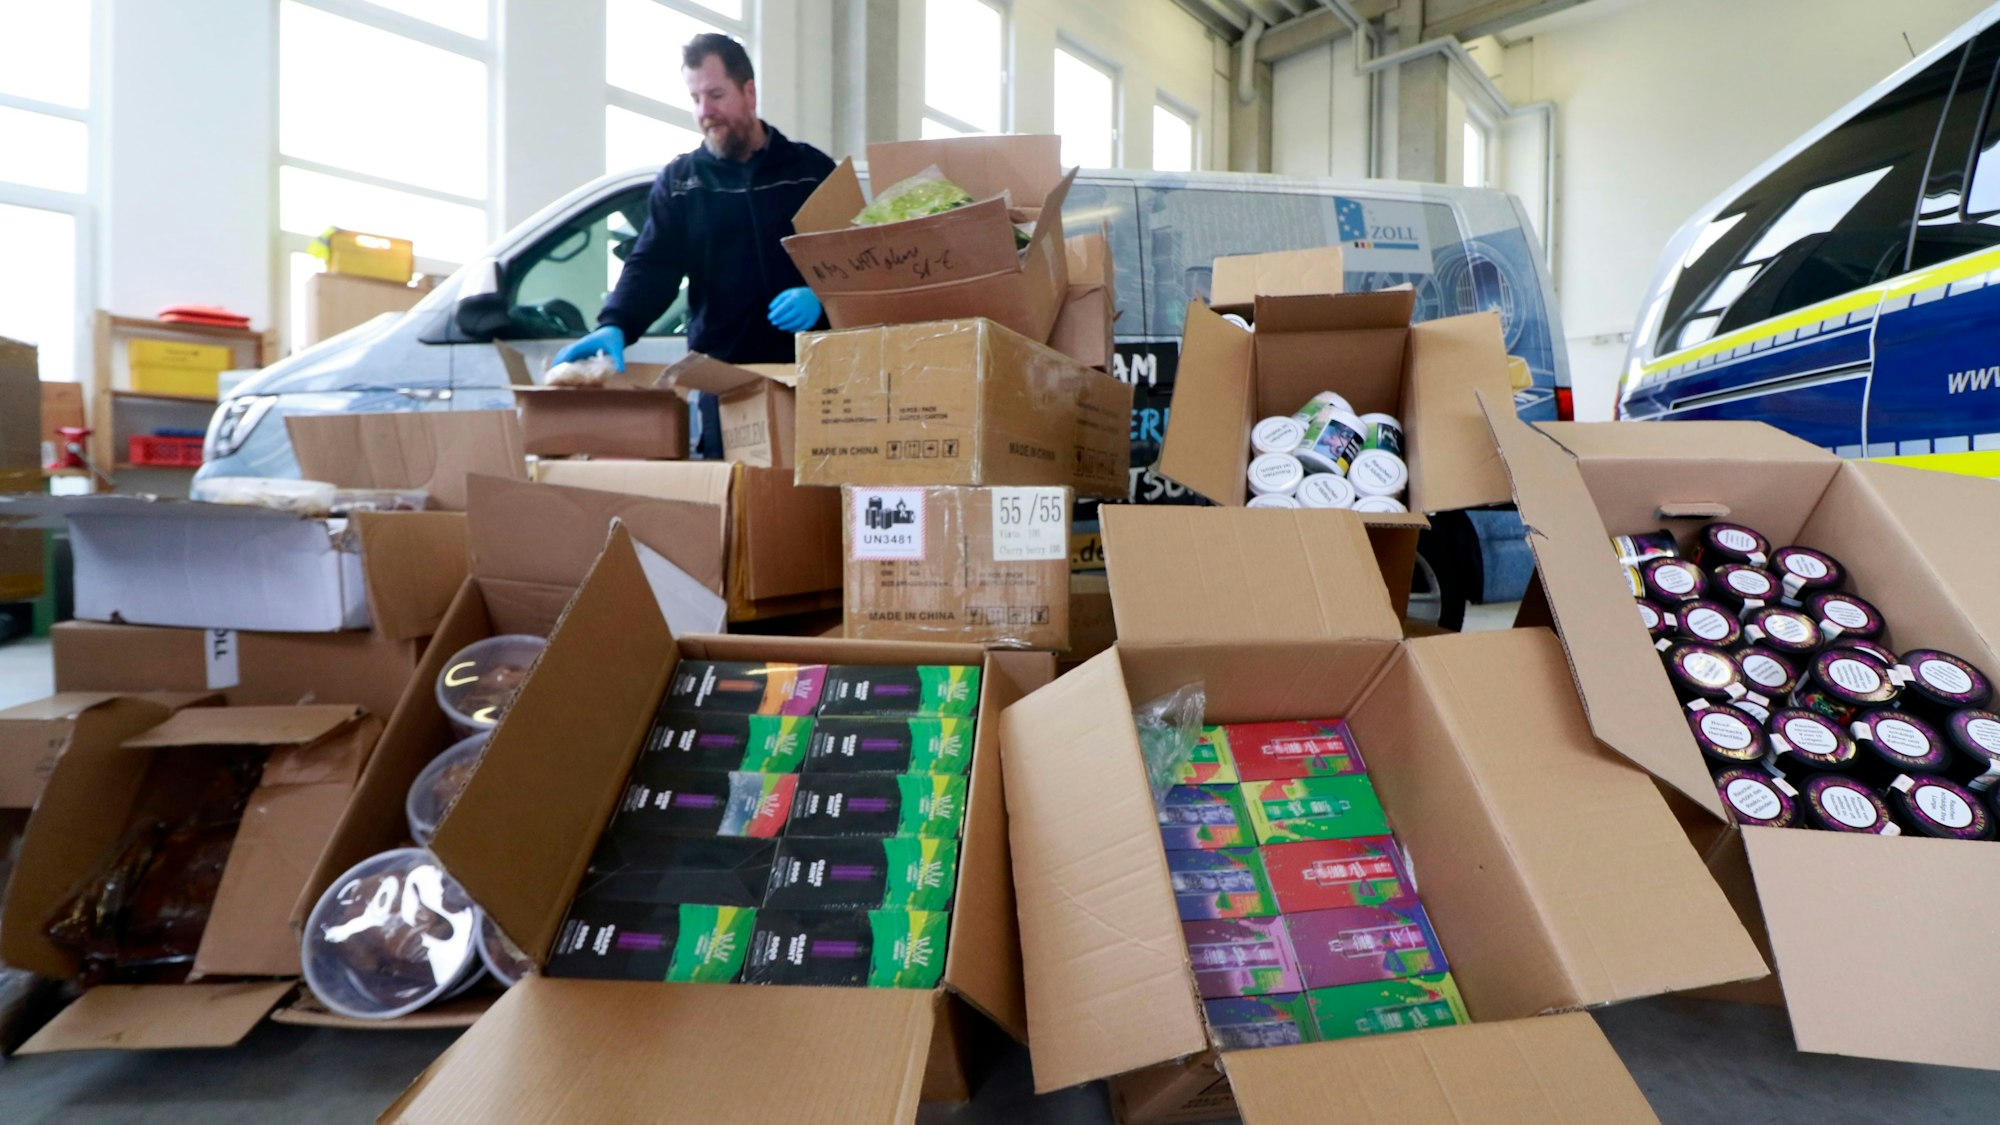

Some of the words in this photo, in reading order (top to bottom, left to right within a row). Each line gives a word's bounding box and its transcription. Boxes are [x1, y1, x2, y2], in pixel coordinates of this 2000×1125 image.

[1371, 225, 1419, 241] ZOLL
[1948, 365, 2000, 394] ww
[811, 447, 837, 457] MADE
[838, 447, 848, 456] IN
[850, 445, 879, 456] CHINA
[1009, 442, 1029, 457] MADE
[1000, 496, 1021, 525] 55
[864, 535, 912, 545] UN3481
[869, 611, 902, 621] MADE
[904, 611, 916, 621] IN
[918, 611, 955, 621] CHINA
[846, 734, 857, 756] GRAPE
[826, 795, 836, 814] MINT
[831, 793, 843, 817] GRAPE
[790, 860, 801, 883] 8000
[807, 862, 818, 883] MINT
[813, 859, 826, 887] GRAPE
[768, 936, 781, 961] 8000
[787, 937, 798, 961] MINT
[794, 933, 807, 965] GRAPE
